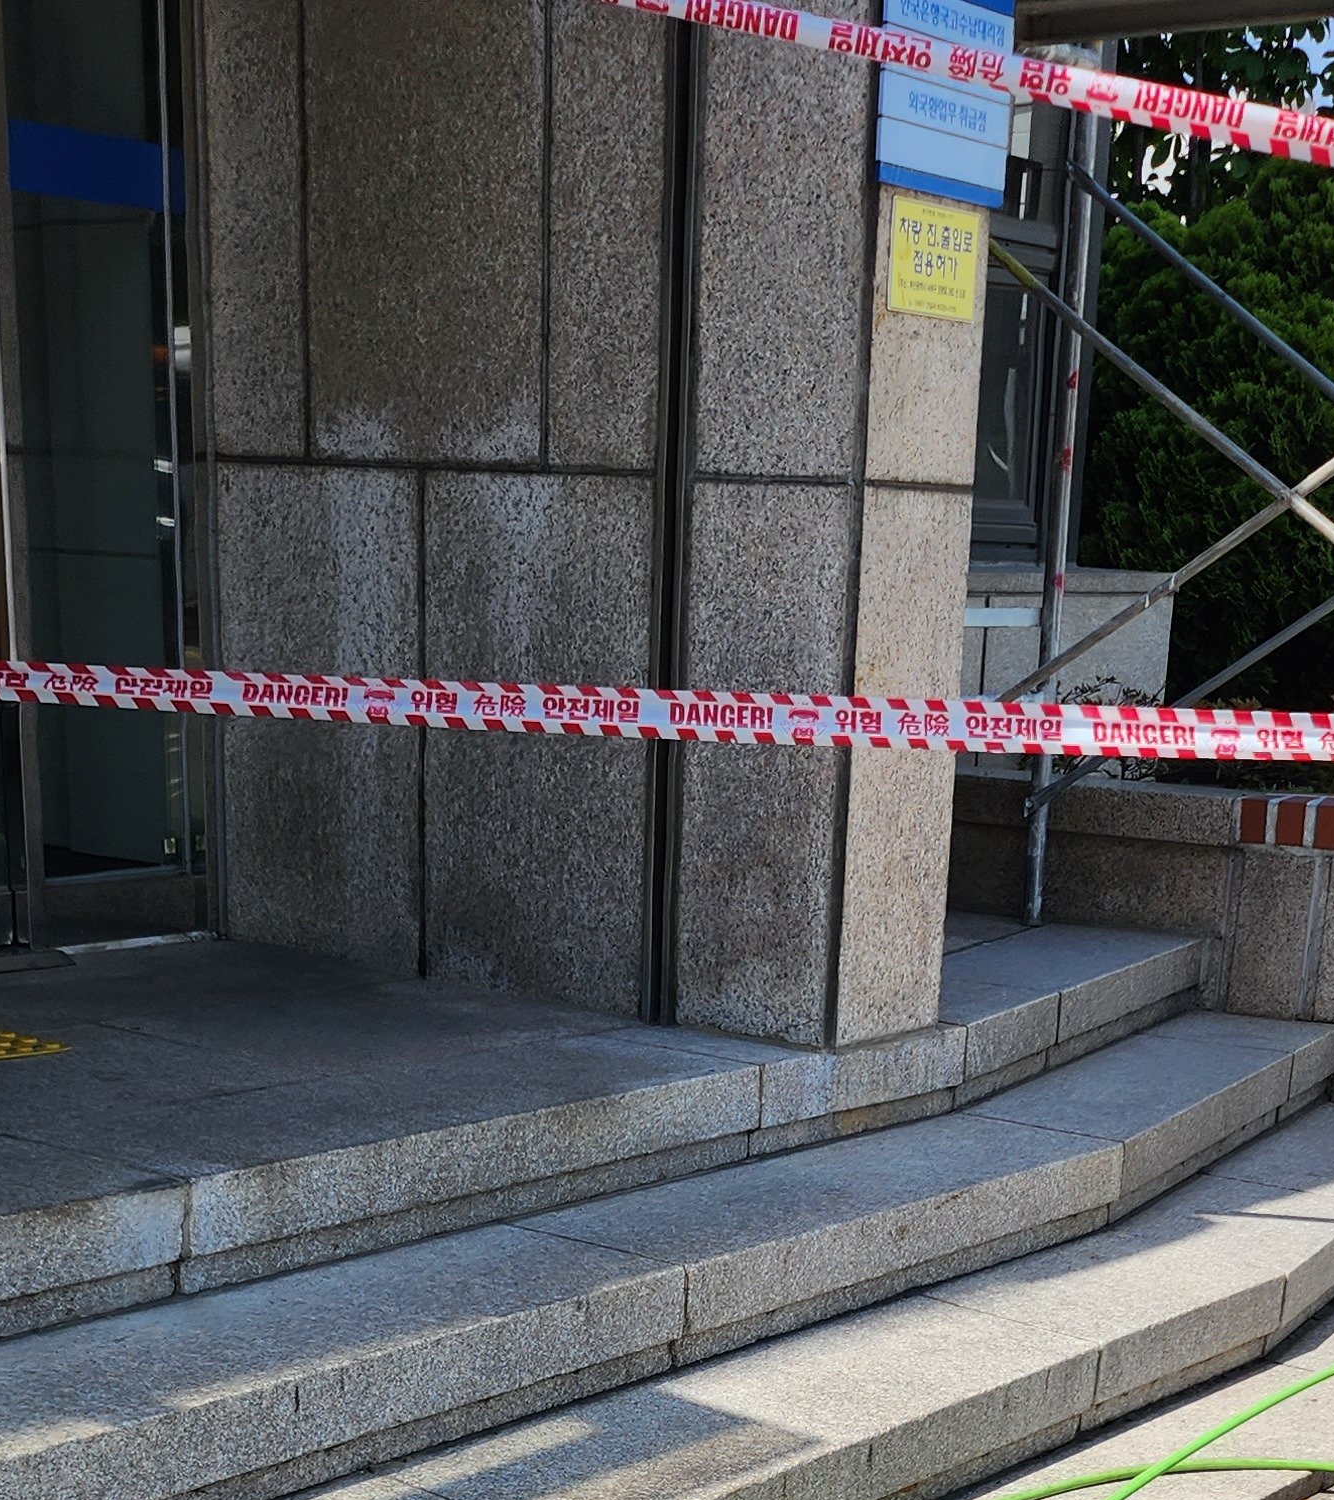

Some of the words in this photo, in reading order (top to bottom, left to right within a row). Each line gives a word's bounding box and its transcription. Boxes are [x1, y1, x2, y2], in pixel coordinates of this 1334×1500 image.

[683, 0, 799, 41] DANGER!
[828, 22, 932, 68] 안전제일
[949, 45, 1006, 82] 危險
[1019, 59, 1072, 96] 위험
[909, 91, 957, 124] 외국환업무
[959, 105, 988, 133] 취급점
[1134, 82, 1246, 128] DANGER!
[899, 217, 923, 245] 차량
[913, 250, 958, 280] 점용허가
[242, 681, 349, 708] DANGER!
[410, 688, 458, 715] 위험
[473, 692, 527, 718] 危險
[542, 696, 640, 723] 안전제일
[669, 701, 774, 729] DANGER!
[834, 708, 882, 735] 위험
[897, 713, 950, 738] 危險
[967, 715, 1063, 742] 안전제일
[1092, 721, 1196, 747] DANGER!
[1256, 728, 1305, 750] 위험
